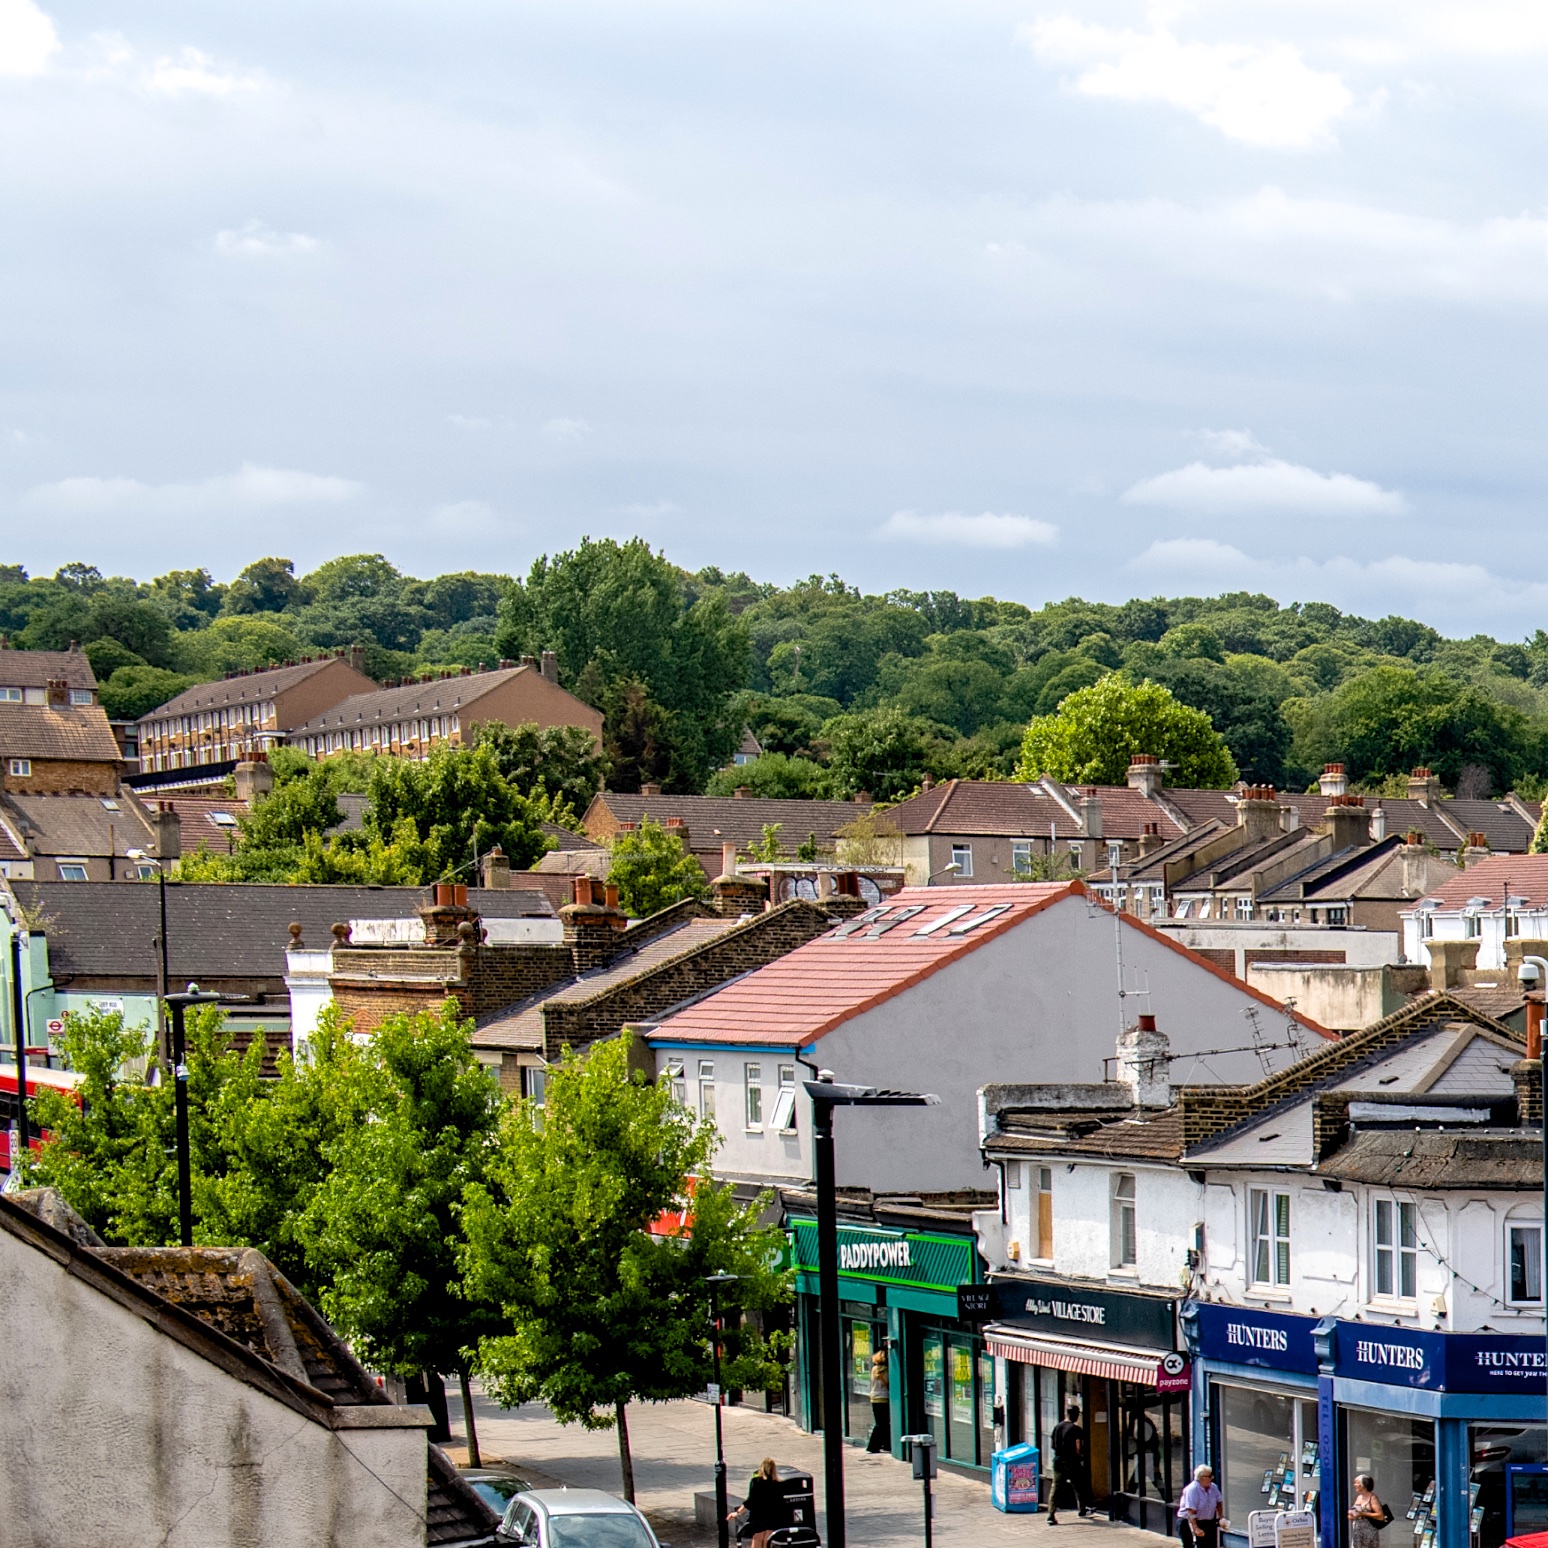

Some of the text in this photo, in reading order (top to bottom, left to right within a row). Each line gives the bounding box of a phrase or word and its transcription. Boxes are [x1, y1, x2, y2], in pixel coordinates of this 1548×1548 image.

[961, 1293, 990, 1302] VILLAGE
[964, 1302, 987, 1311] STORE
[1227, 1323, 1288, 1351] HUNTERS
[1356, 1340, 1424, 1370] HUNTERS
[1159, 1378, 1189, 1388] payzone
